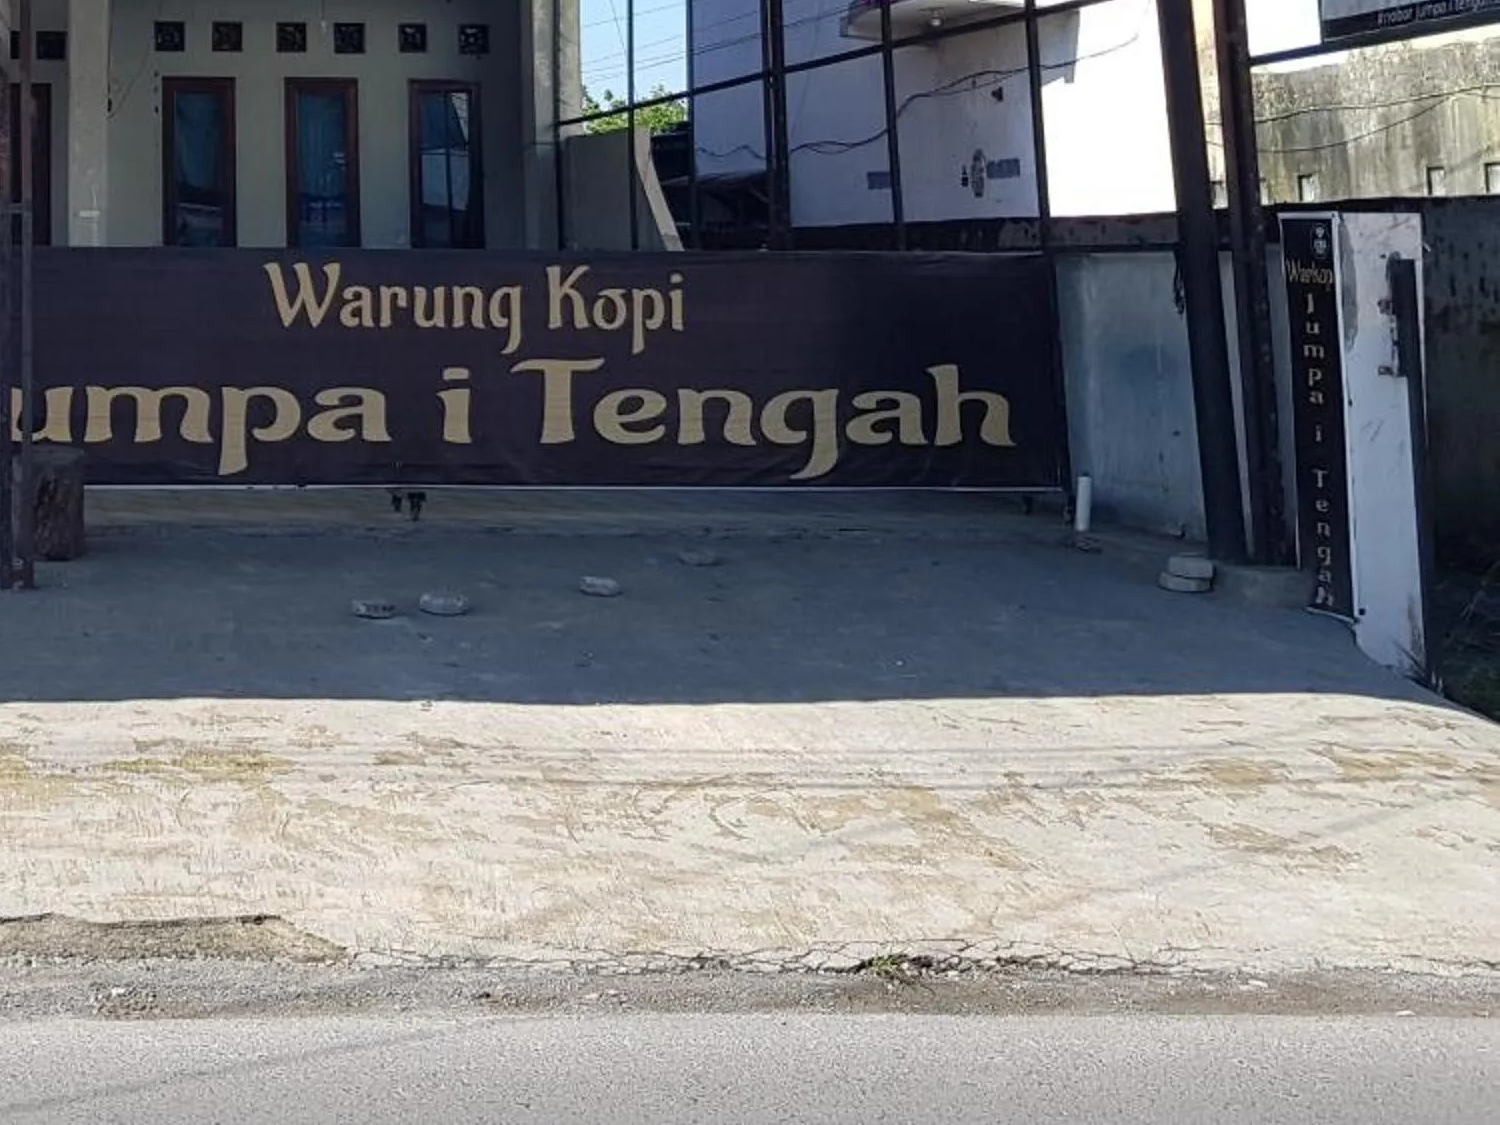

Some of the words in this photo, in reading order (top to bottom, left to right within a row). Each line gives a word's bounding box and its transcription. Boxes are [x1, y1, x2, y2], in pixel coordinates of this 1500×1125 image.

[263, 261, 522, 354] Warung
[545, 264, 685, 355] Kopi
[435, 367, 472, 443] i
[510, 358, 1016, 480] Tengah
